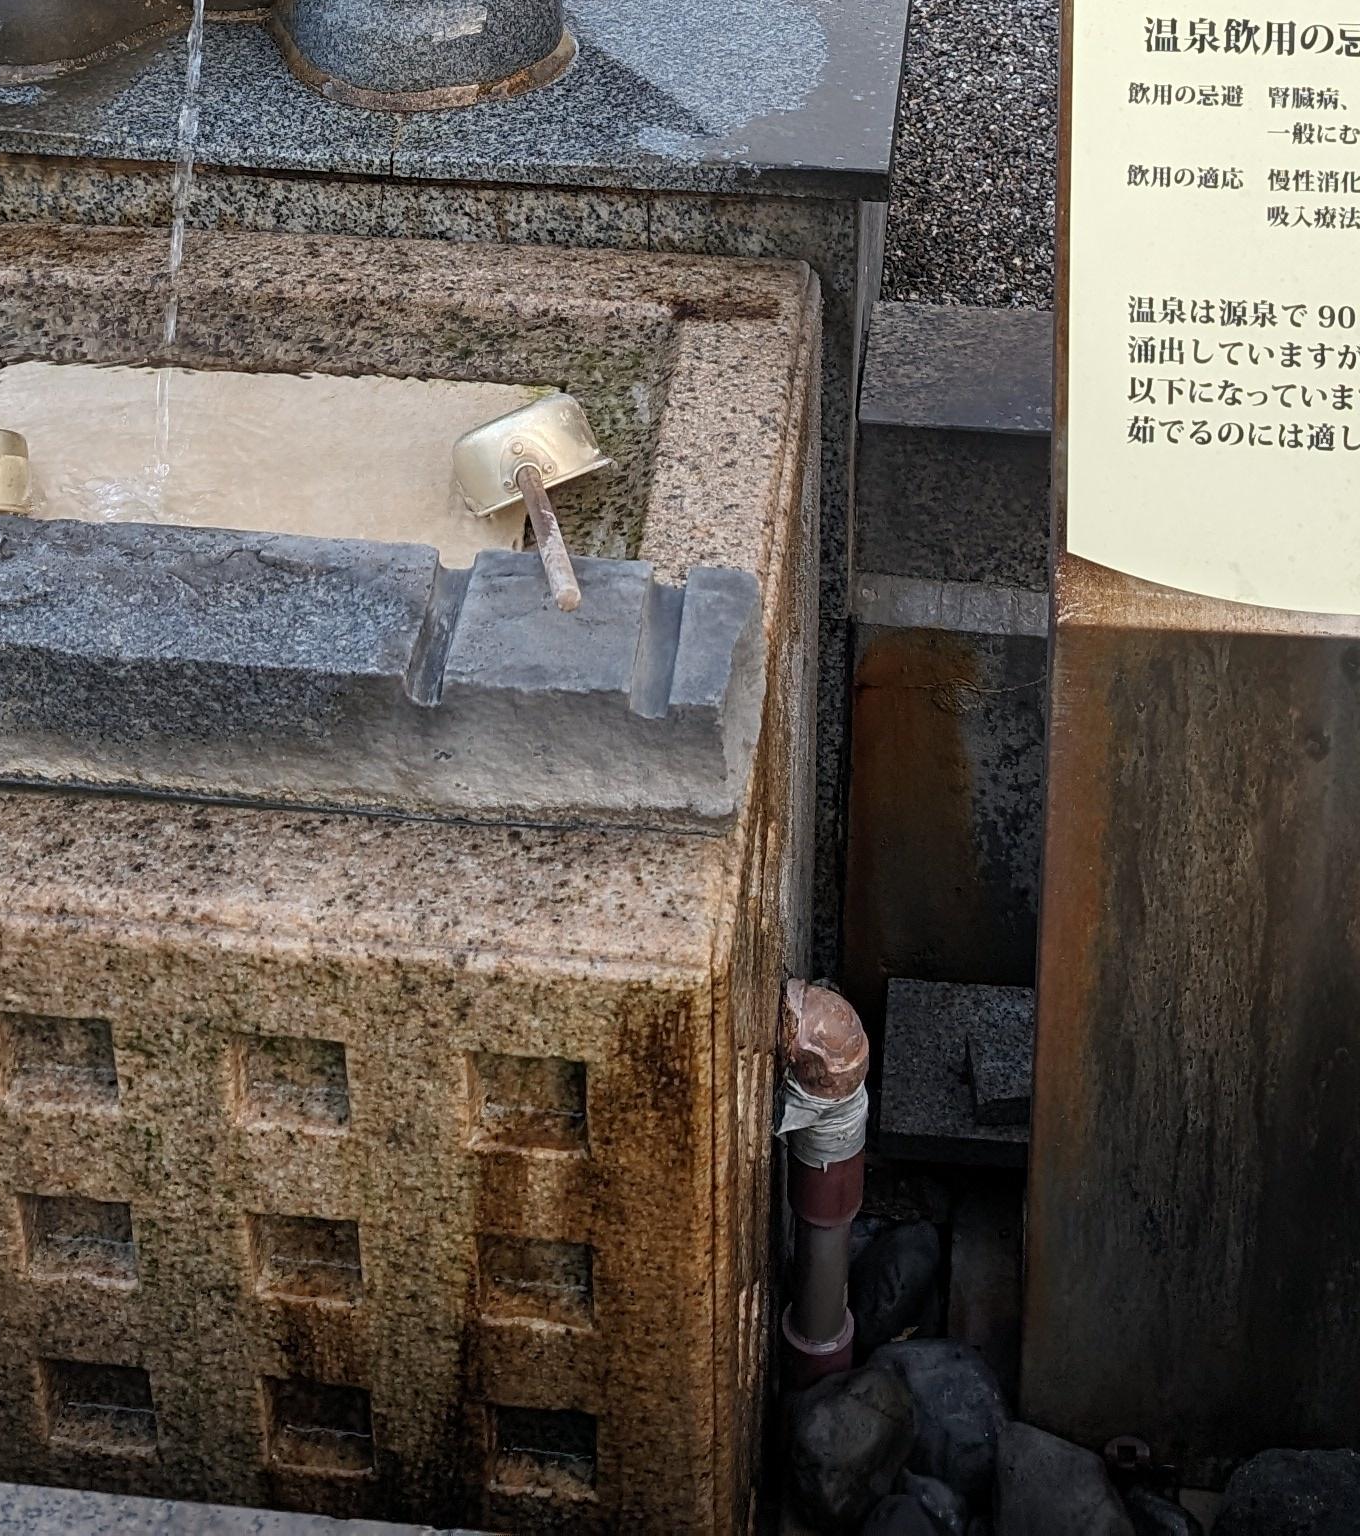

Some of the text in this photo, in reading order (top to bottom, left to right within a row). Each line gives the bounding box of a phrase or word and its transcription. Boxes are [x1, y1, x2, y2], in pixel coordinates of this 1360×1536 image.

[1127, 81, 1244, 108] 飲用の忌避
[1126, 163, 1245, 190] 飲用の適応
